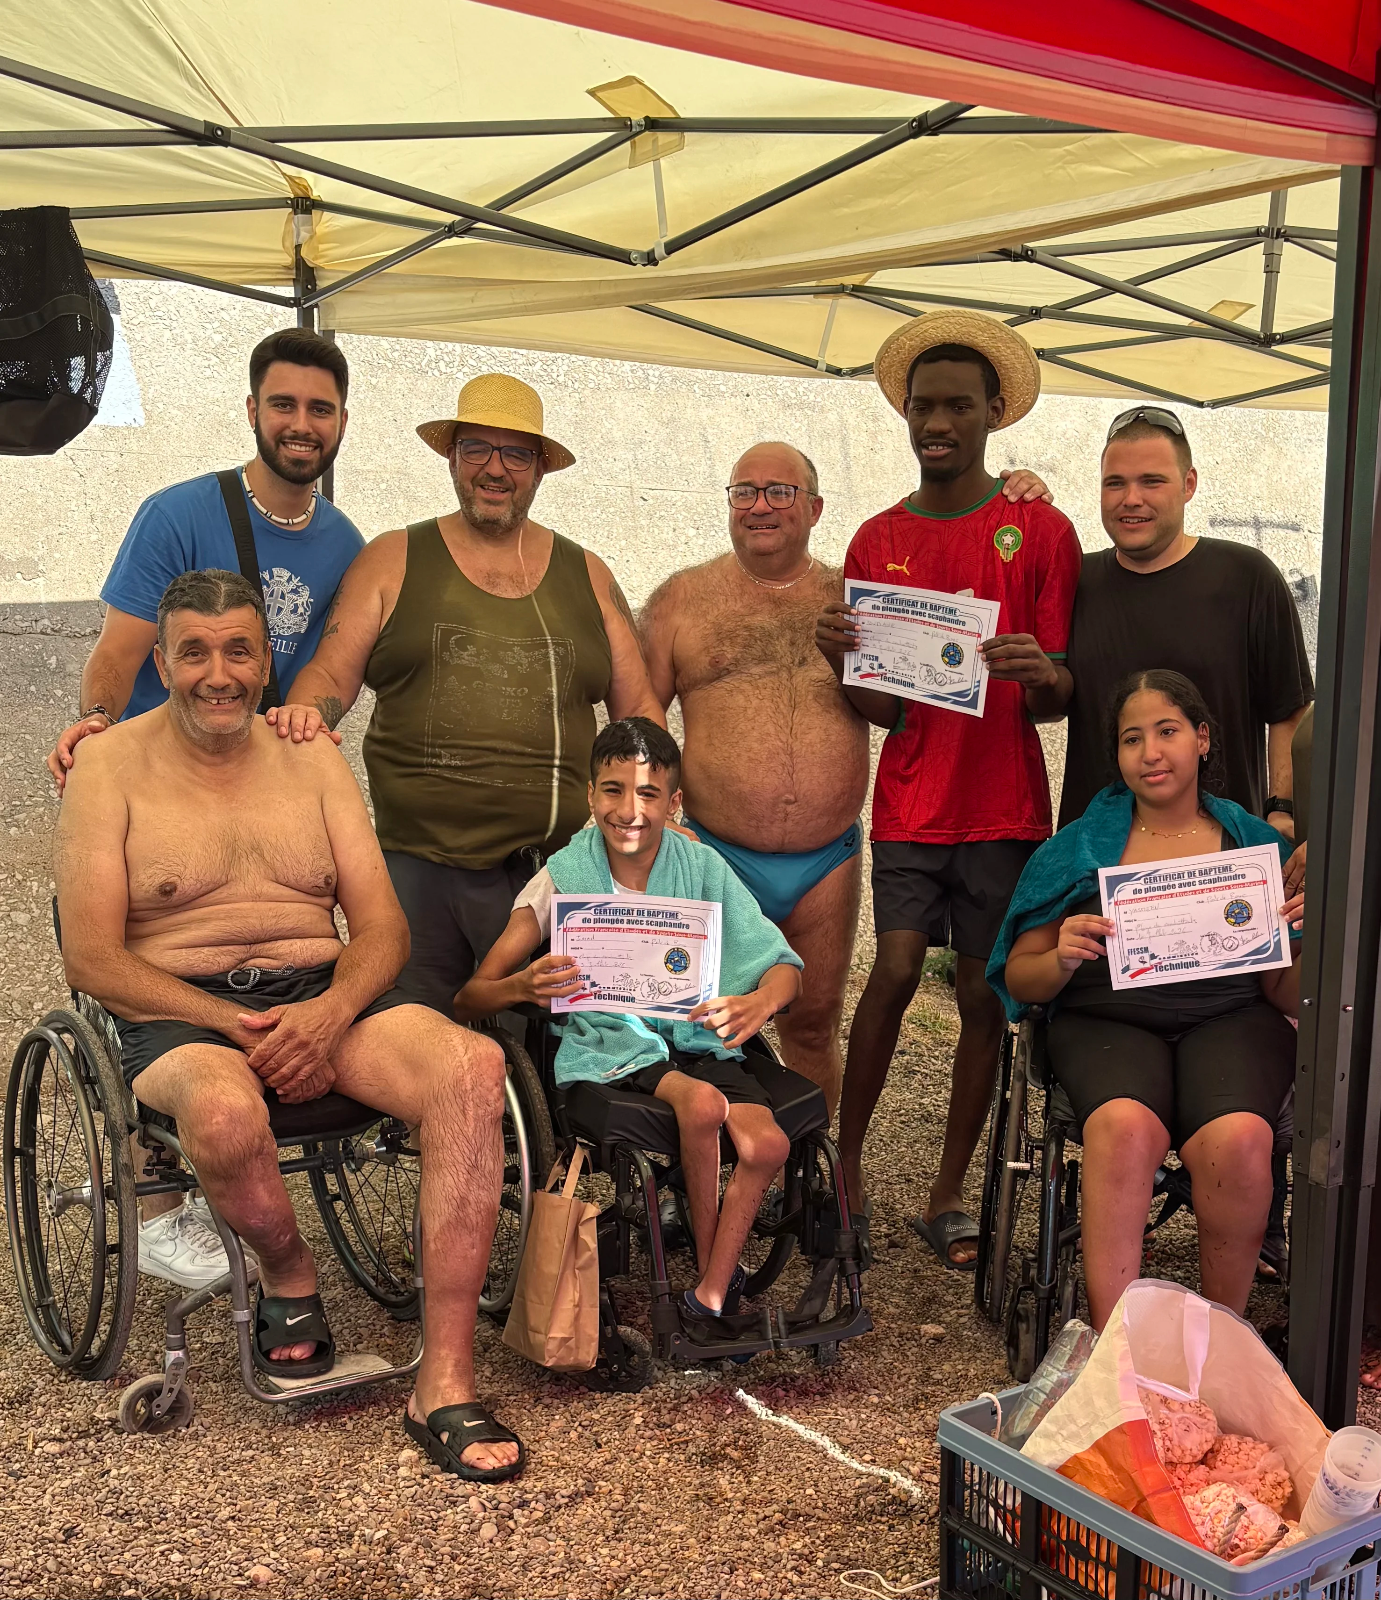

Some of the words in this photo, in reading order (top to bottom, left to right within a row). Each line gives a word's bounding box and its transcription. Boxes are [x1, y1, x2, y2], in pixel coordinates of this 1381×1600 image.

[880, 674, 916, 689] Technique
[1143, 871, 1186, 884] CERTIFICAT
[1187, 870, 1197, 878] DE
[1198, 865, 1233, 877] BAPTEME
[1132, 887, 1143, 895] de
[1177, 880, 1196, 888] avec
[1198, 872, 1246, 886] scaphandre
[593, 907, 634, 917] CERTIFICAT
[582, 916, 592, 924] de
[646, 920, 690, 930] scaphandre
[1154, 959, 1201, 974] Technique
[593, 992, 636, 1003] Technique
